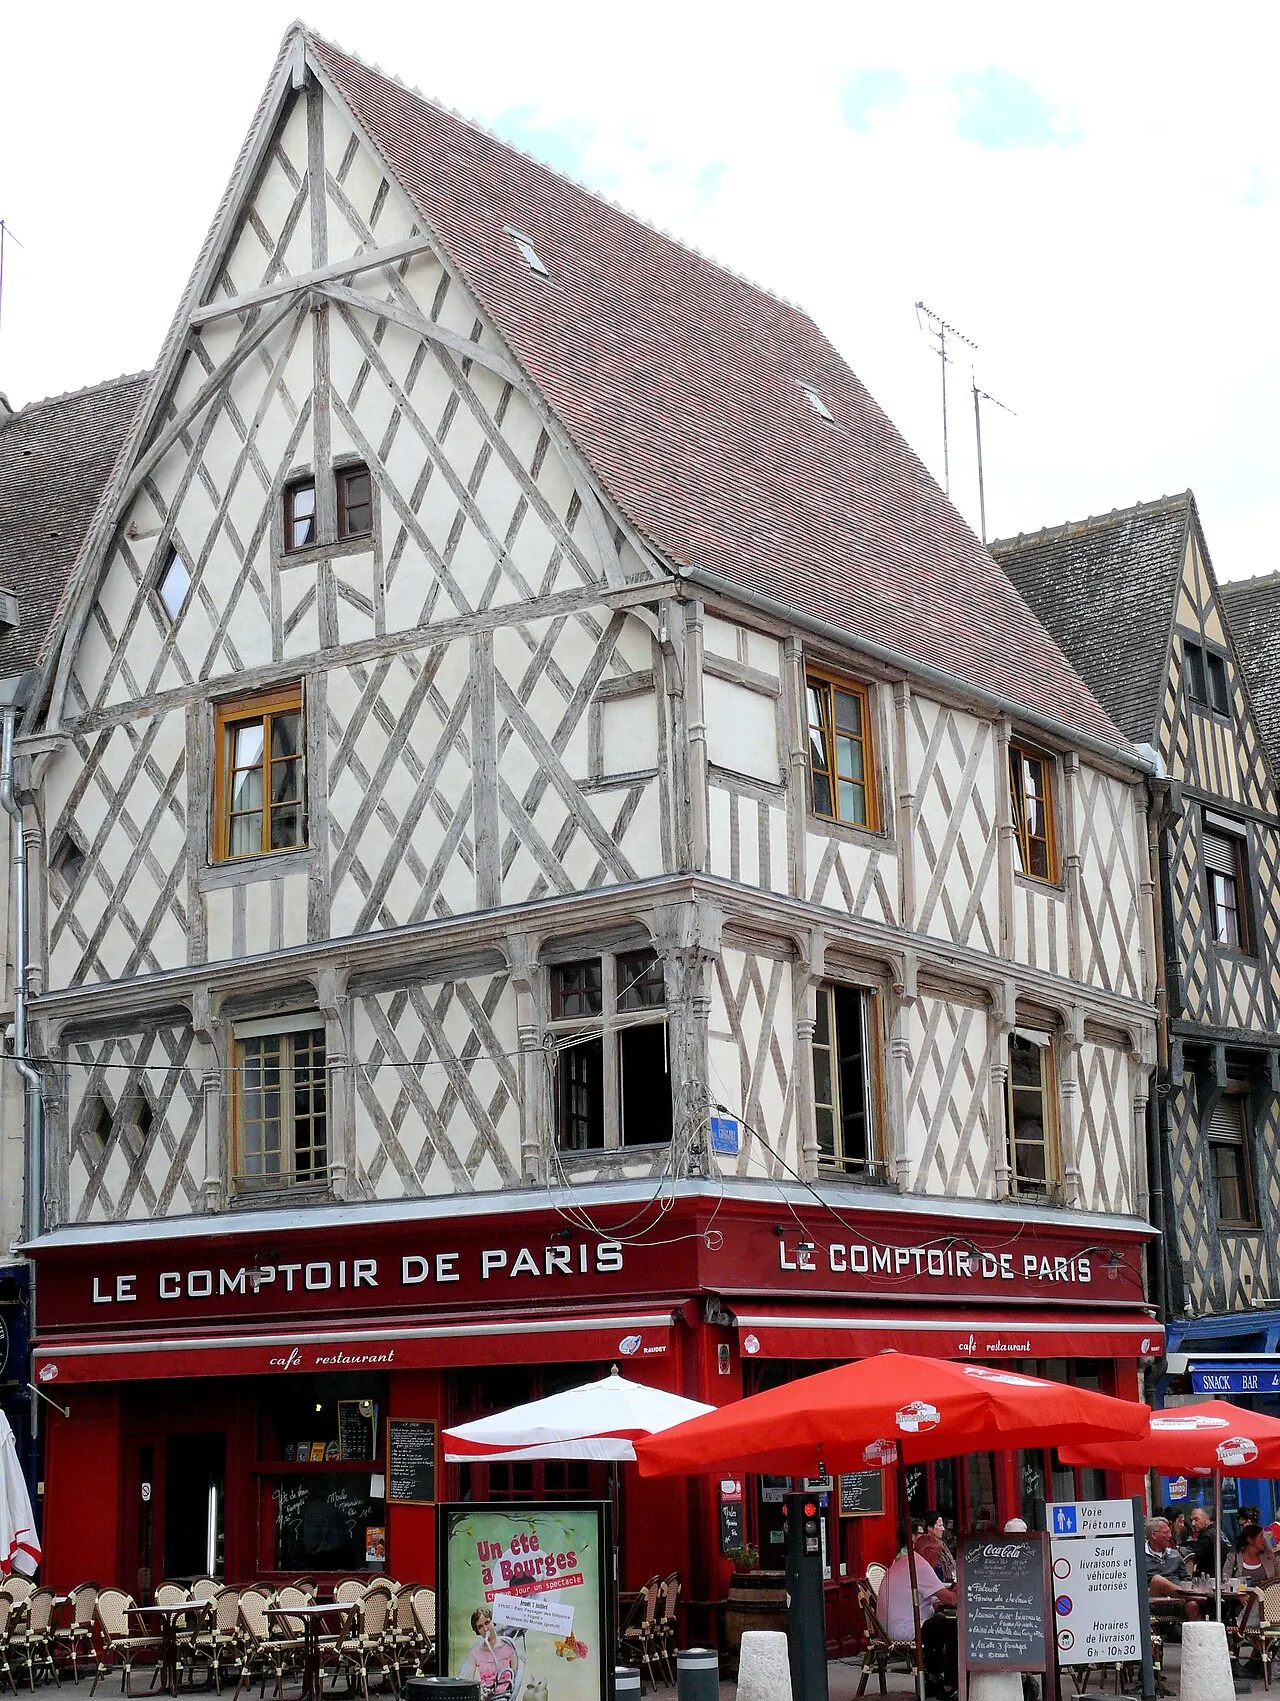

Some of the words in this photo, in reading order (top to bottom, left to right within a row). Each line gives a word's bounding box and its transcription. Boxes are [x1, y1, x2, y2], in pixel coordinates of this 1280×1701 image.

[779, 1241, 816, 1271] LE
[829, 1244, 972, 1277] COMPTOIR
[982, 1252, 1014, 1279] DE
[1024, 1255, 1091, 1283] PARIS
[93, 1275, 137, 1303] LE
[160, 1259, 379, 1299] COMPTOIR
[402, 1252, 460, 1284] DE
[482, 1242, 623, 1279] PARIS
[958, 1333, 977, 1356] café
[986, 1340, 1031, 1352] restaurant
[269, 1347, 302, 1371] café
[315, 1349, 395, 1365] restaurant
[1203, 1375, 1231, 1390] SNACK
[1242, 1375, 1258, 1389] BAR
[1081, 1507, 1102, 1517] Voie
[1082, 1520, 1126, 1530] Piétonne
[476, 1540, 502, 1562] Un
[510, 1530, 540, 1556] été
[1094, 1547, 1114, 1557] Sauf
[481, 1564, 493, 1585] à
[500, 1550, 578, 1582] Bourges
[1079, 1559, 1121, 1569] livraisons
[1123, 1558, 1132, 1568] et
[1086, 1570, 1127, 1581] véhicules
[515, 1586, 530, 1596] jour
[545, 1575, 582, 1590] spectacle
[1088, 1581, 1128, 1592] autorisés
[1092, 1621, 1129, 1631] Horaires
[1086, 1634, 1096, 1644] de
[1098, 1633, 1135, 1643] livraison
